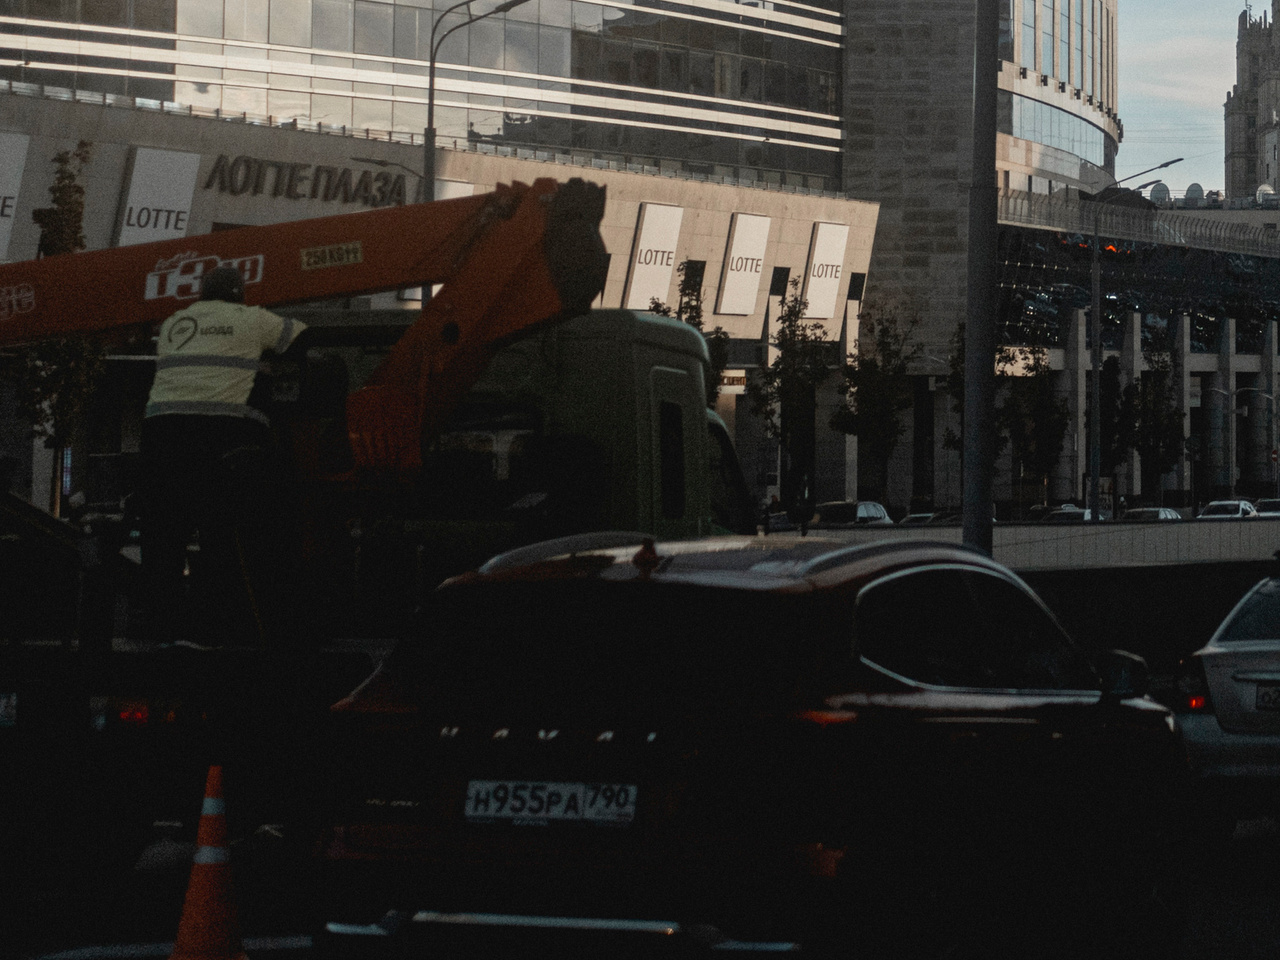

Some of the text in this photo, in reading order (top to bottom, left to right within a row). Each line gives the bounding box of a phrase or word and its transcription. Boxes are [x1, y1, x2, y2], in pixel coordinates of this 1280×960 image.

[126, 206, 187, 230] LOTTE
[638, 249, 674, 267] LOTTE
[730, 256, 762, 273] LOTTE
[811, 263, 841, 279] LOTTE
[589, 785, 630, 810] 790
